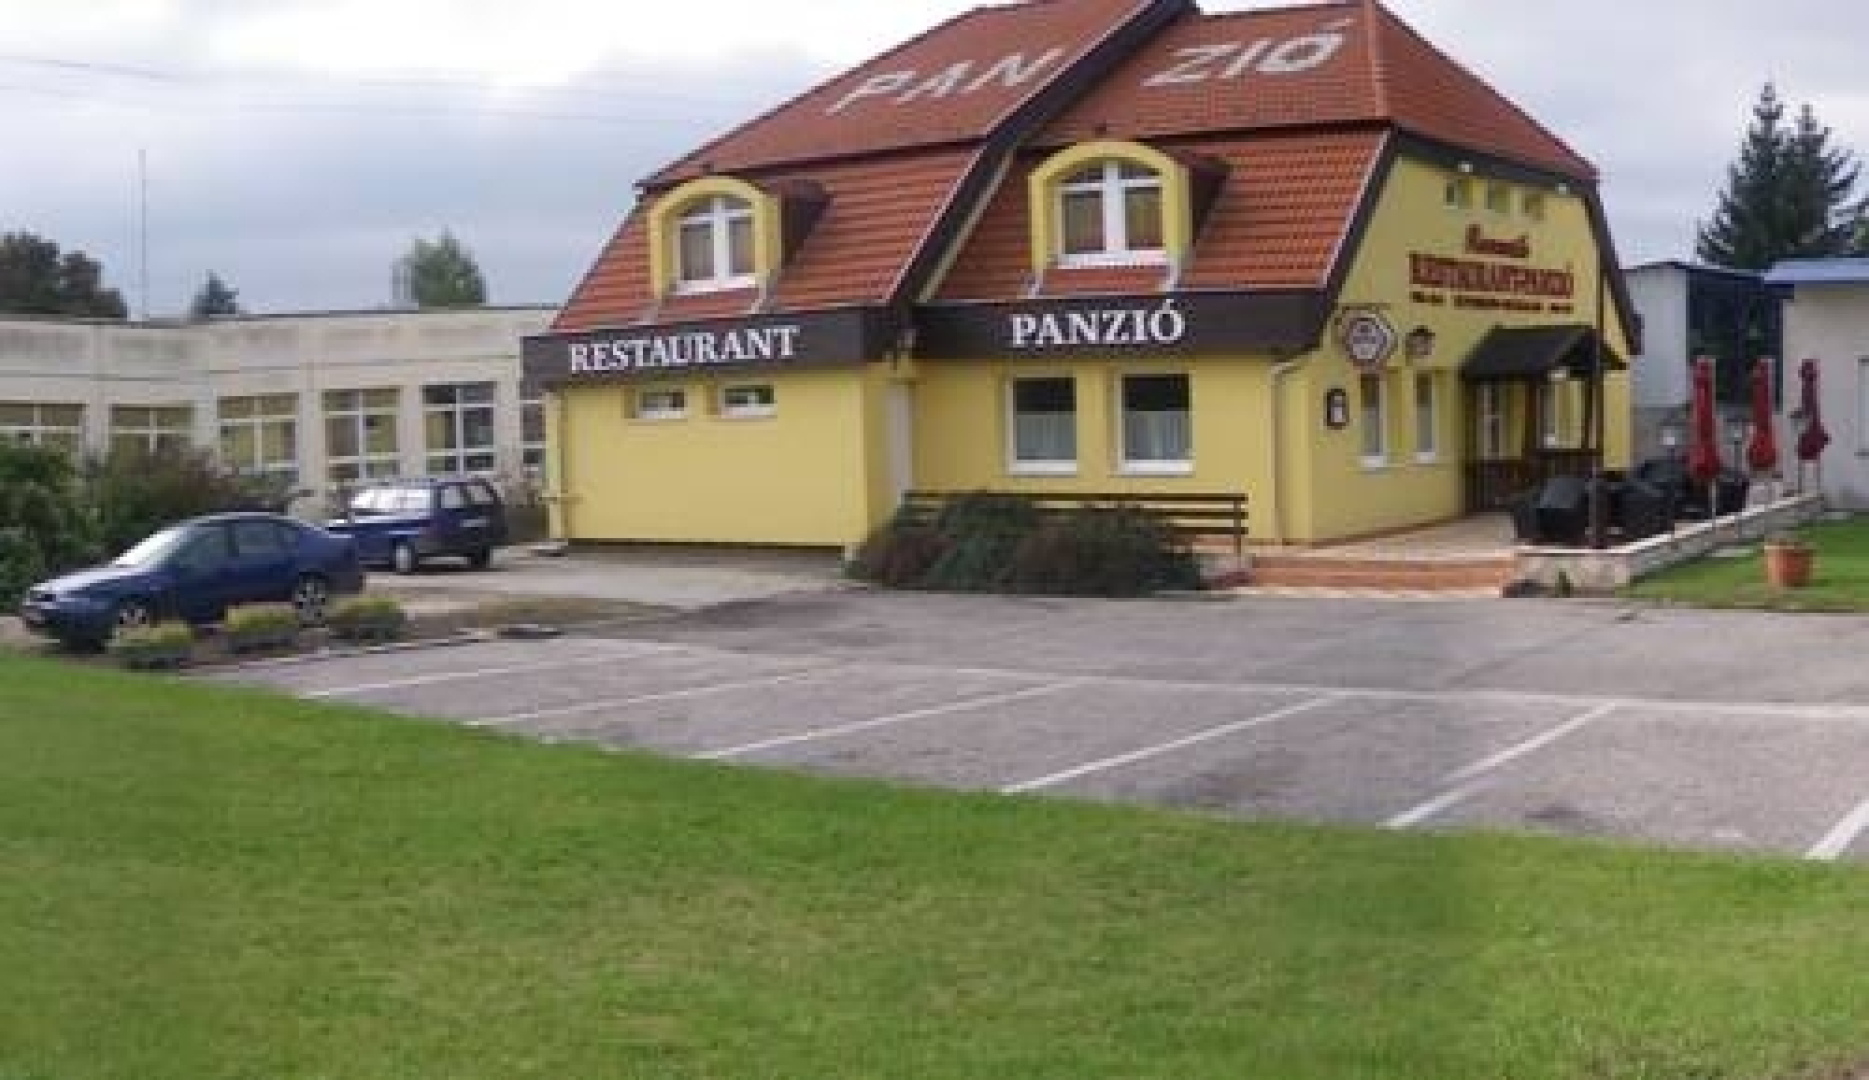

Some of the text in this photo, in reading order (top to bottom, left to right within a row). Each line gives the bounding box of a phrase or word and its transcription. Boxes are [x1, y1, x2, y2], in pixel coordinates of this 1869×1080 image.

[826, 48, 1063, 115] PAN
[1011, 298, 1186, 347] PANZIÓ
[569, 325, 800, 371] RESTAURANT
